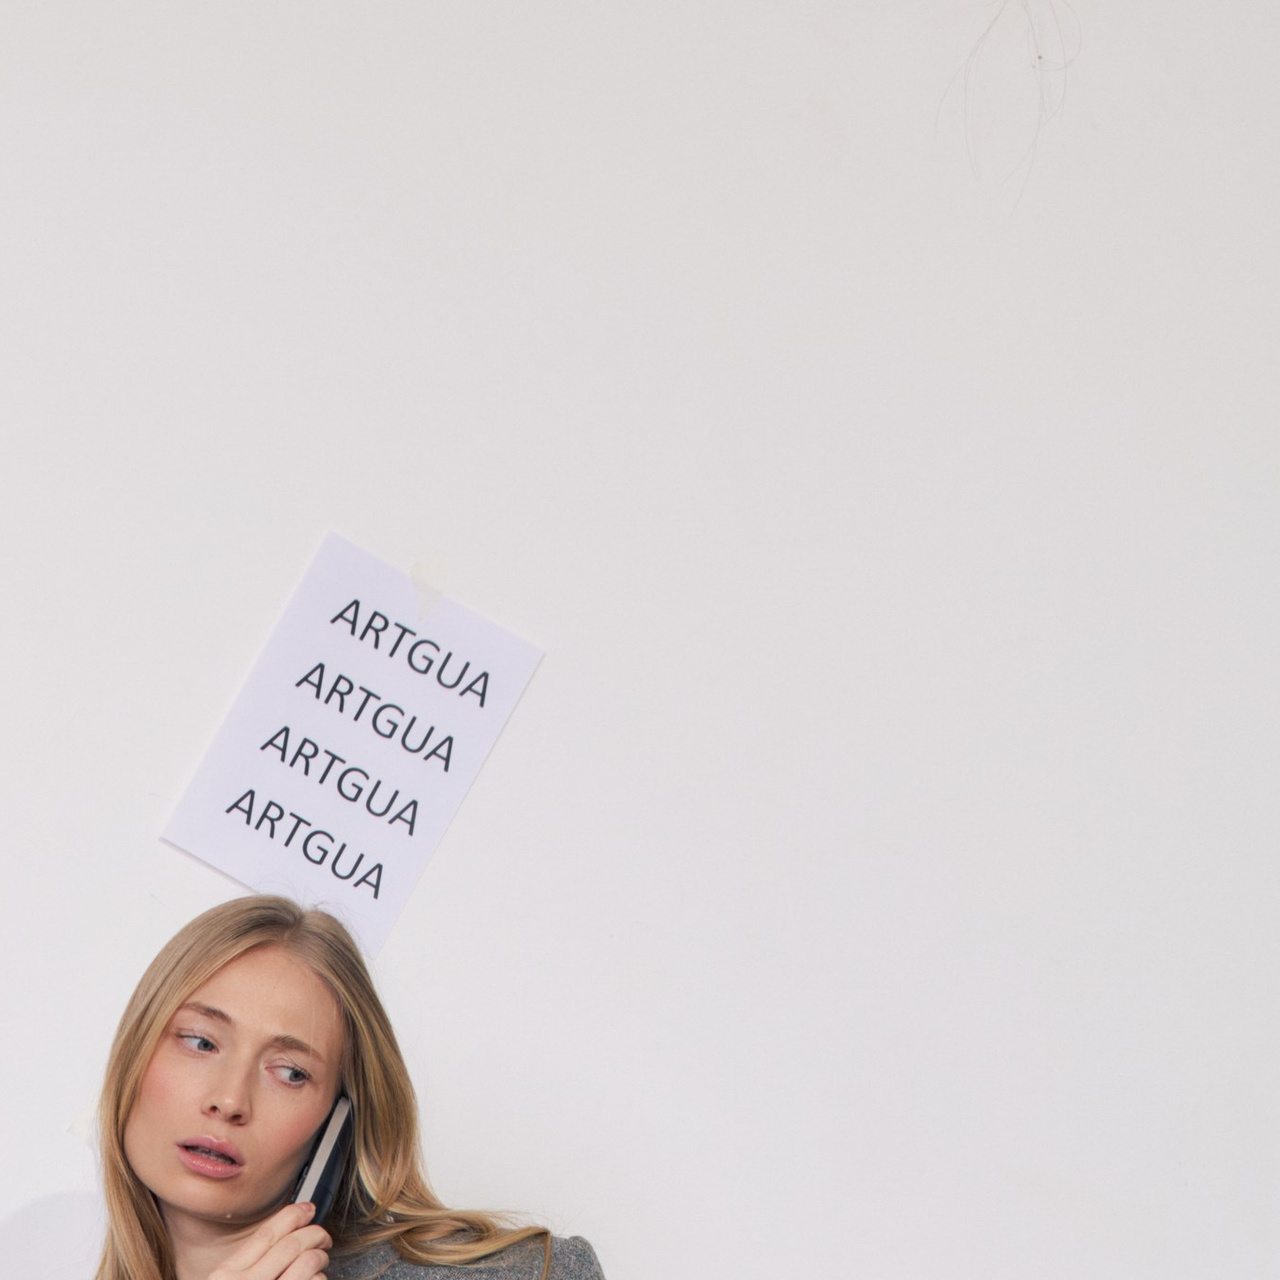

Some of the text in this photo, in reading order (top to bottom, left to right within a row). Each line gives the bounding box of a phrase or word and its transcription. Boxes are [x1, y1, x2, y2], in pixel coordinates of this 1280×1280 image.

[330, 599, 489, 708] ARTGUA
[295, 663, 453, 772] ARTGUA
[260, 726, 418, 836] ARTGUA
[225, 789, 383, 899] ARTGUA
